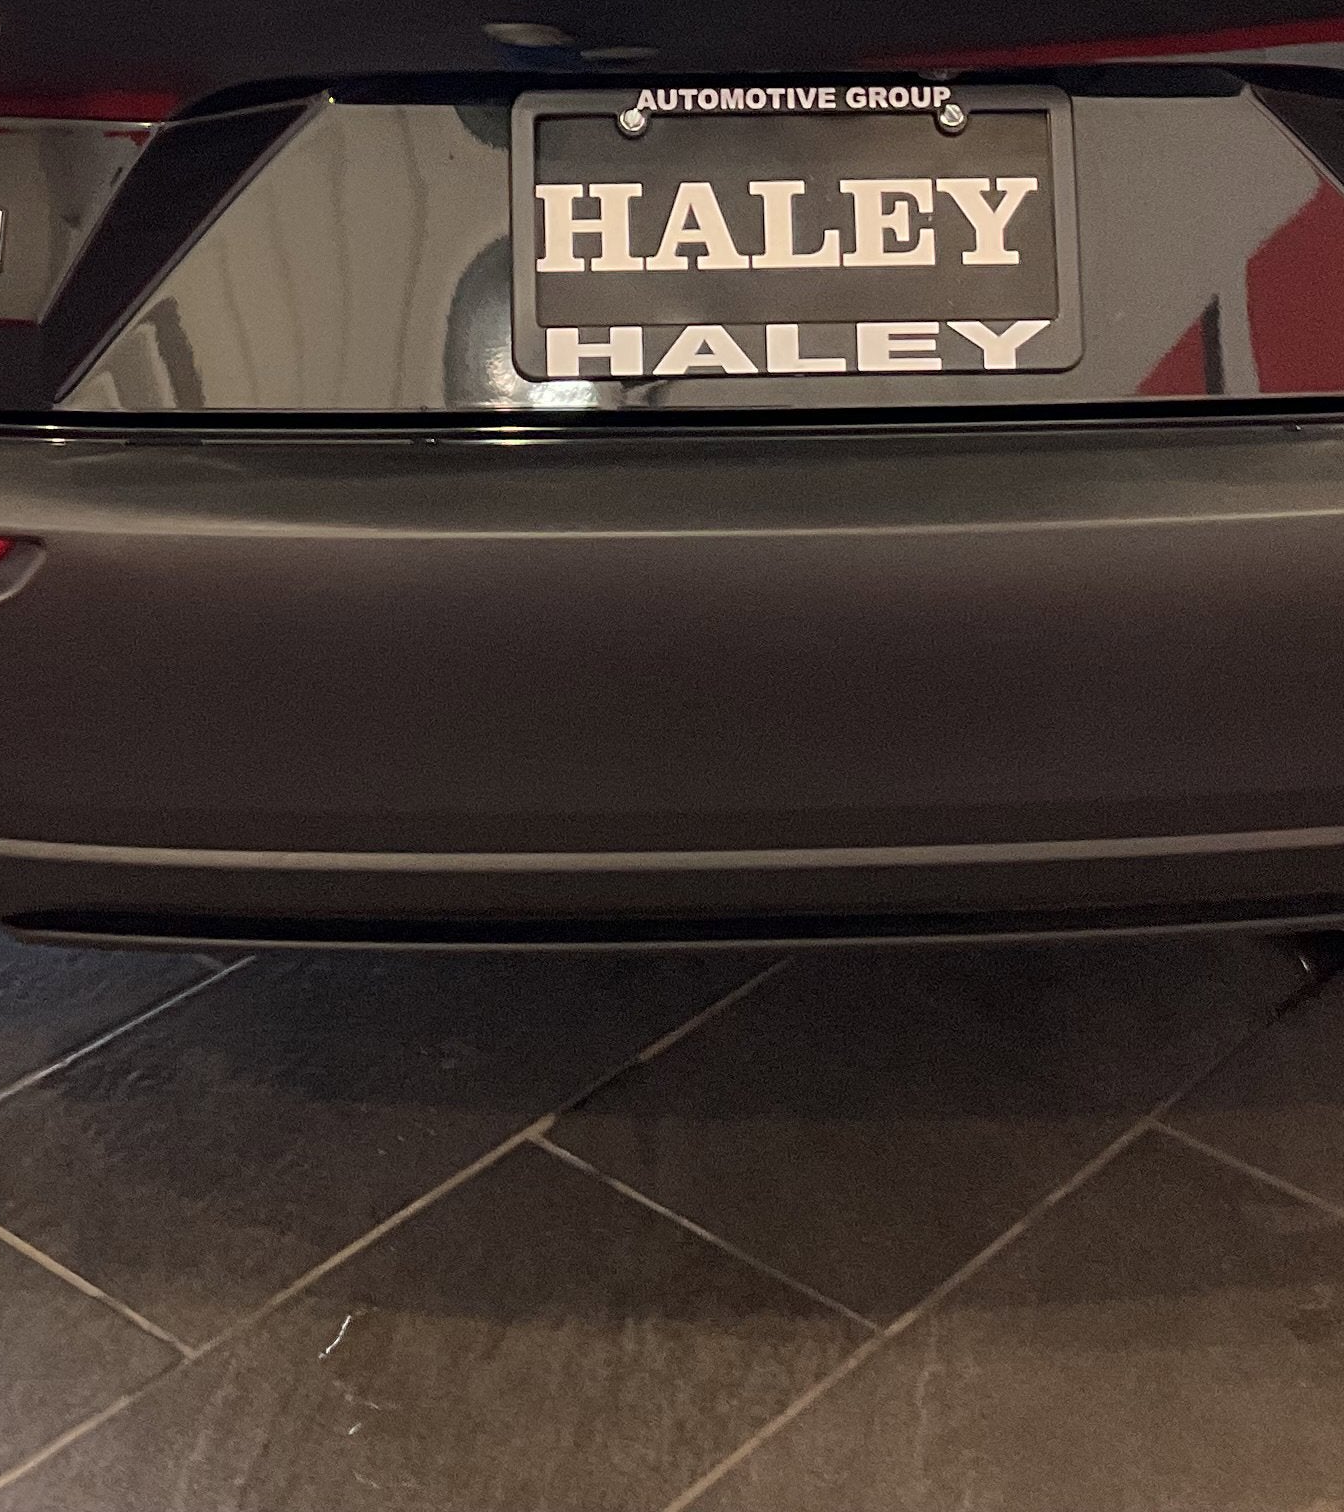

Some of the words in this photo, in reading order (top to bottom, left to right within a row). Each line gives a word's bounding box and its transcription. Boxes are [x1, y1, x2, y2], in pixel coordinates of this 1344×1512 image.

[636, 88, 836, 111] AUTOMOTIVE
[845, 86, 953, 110] GROUP
[535, 177, 1038, 273] HALEY
[546, 319, 1051, 377] HALEY
